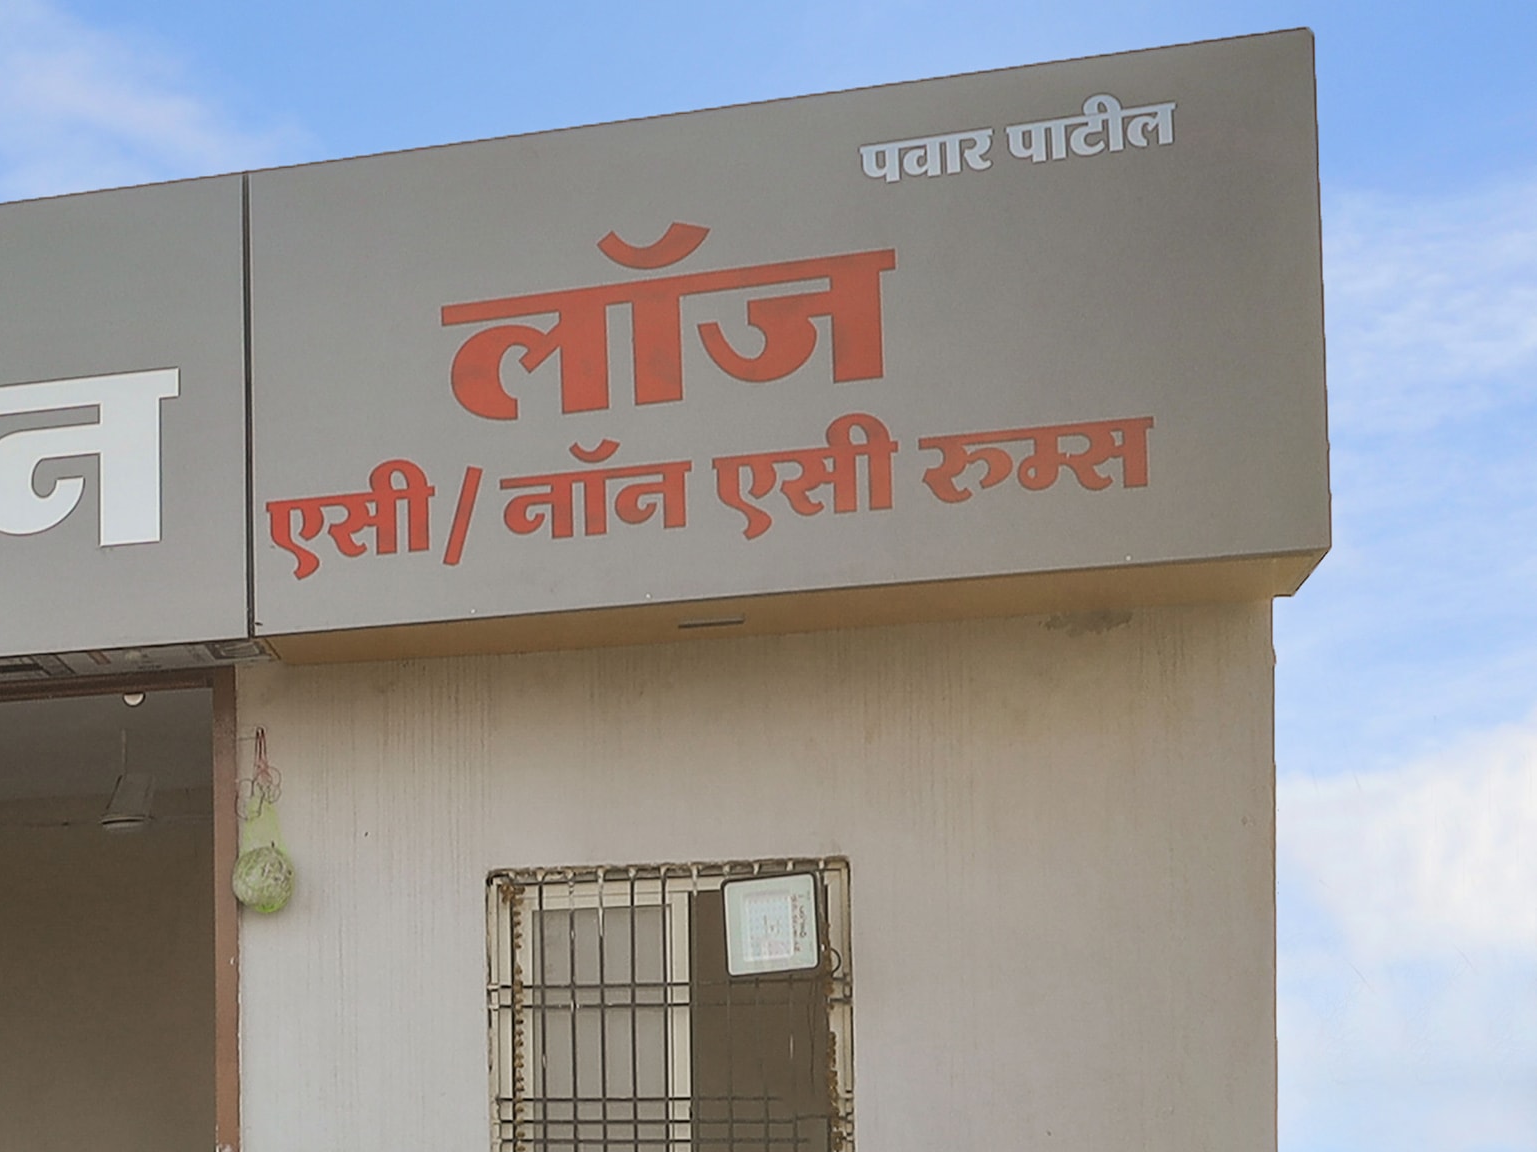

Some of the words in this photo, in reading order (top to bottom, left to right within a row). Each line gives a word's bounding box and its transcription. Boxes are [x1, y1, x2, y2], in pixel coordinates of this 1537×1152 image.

[859, 128, 993, 182] पवार
[1006, 93, 1176, 163] पाटील
[441, 222, 896, 420] लॉज
[499, 439, 692, 539] नॉन
[712, 413, 898, 540] एसी
[917, 416, 1155, 504] रुम्स
